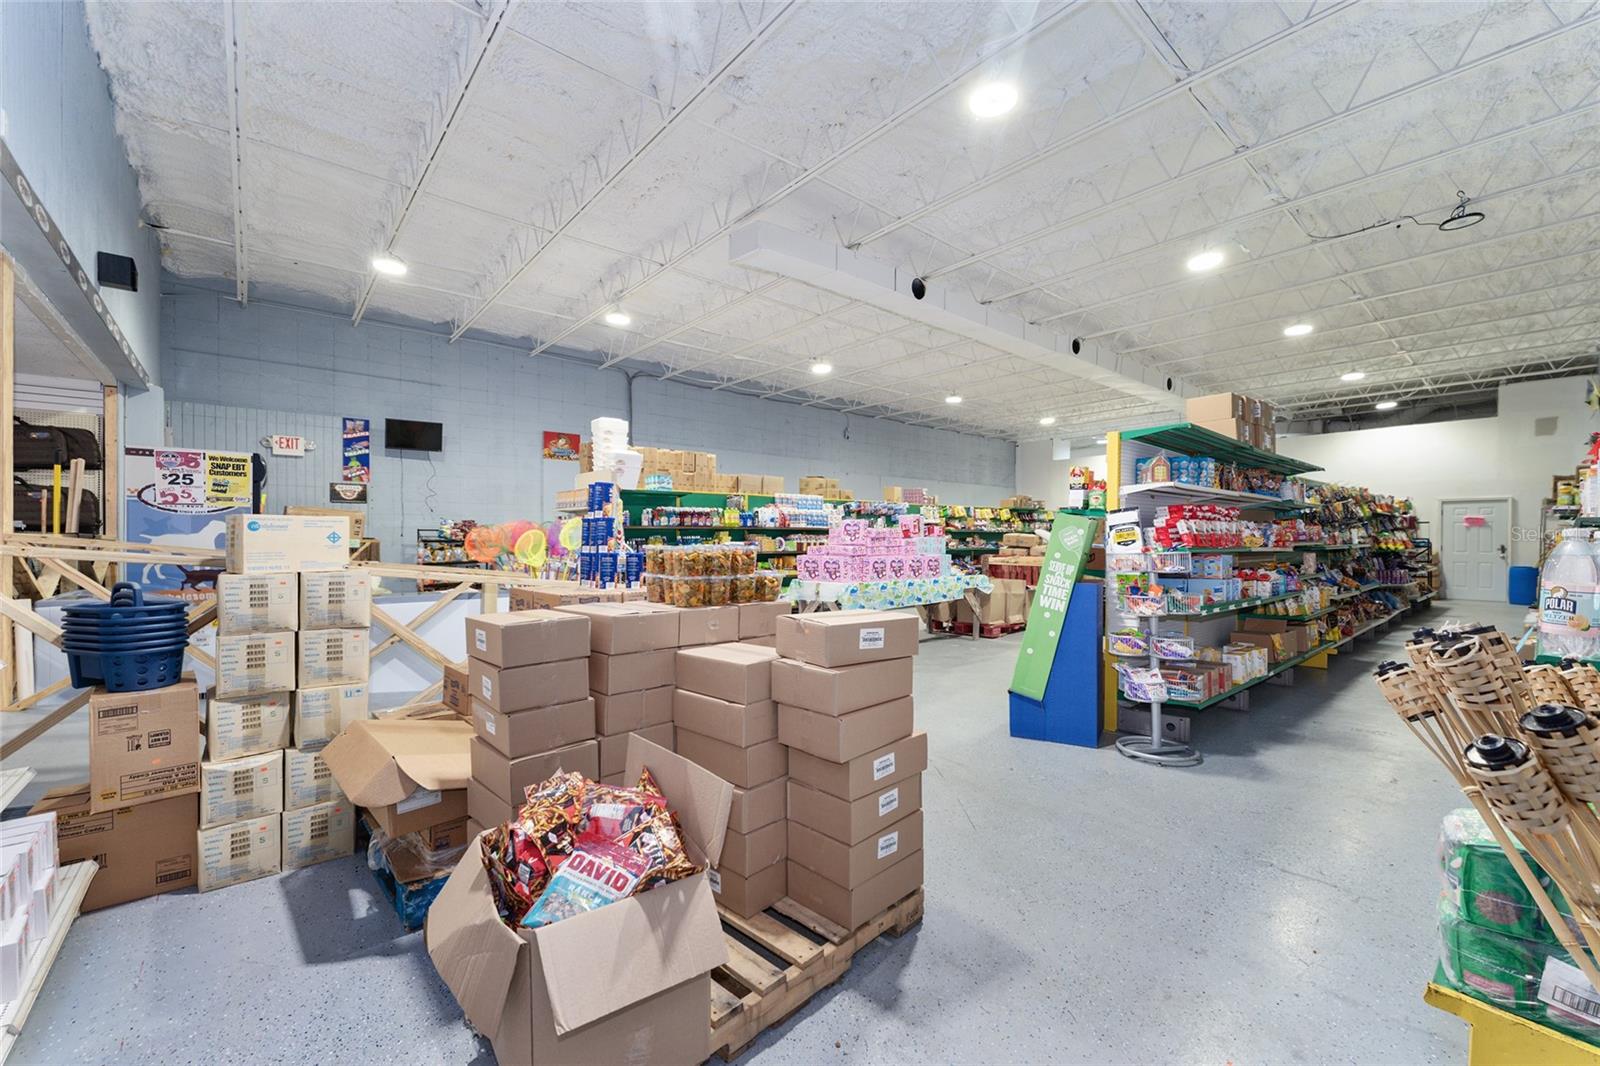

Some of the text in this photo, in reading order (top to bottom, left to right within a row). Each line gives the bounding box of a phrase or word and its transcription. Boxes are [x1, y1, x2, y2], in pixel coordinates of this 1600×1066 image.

[278, 437, 300, 450] EXIT
[210, 462, 231, 470] SNAP
[162, 473, 194, 486] $25
[208, 469, 248, 478] Customers
[1044, 574, 1072, 590] SNACK
[1042, 584, 1069, 600] TIME
[1040, 595, 1066, 612] WIN
[1545, 598, 1574, 612] POLAR
[567, 853, 630, 893] DAVID
